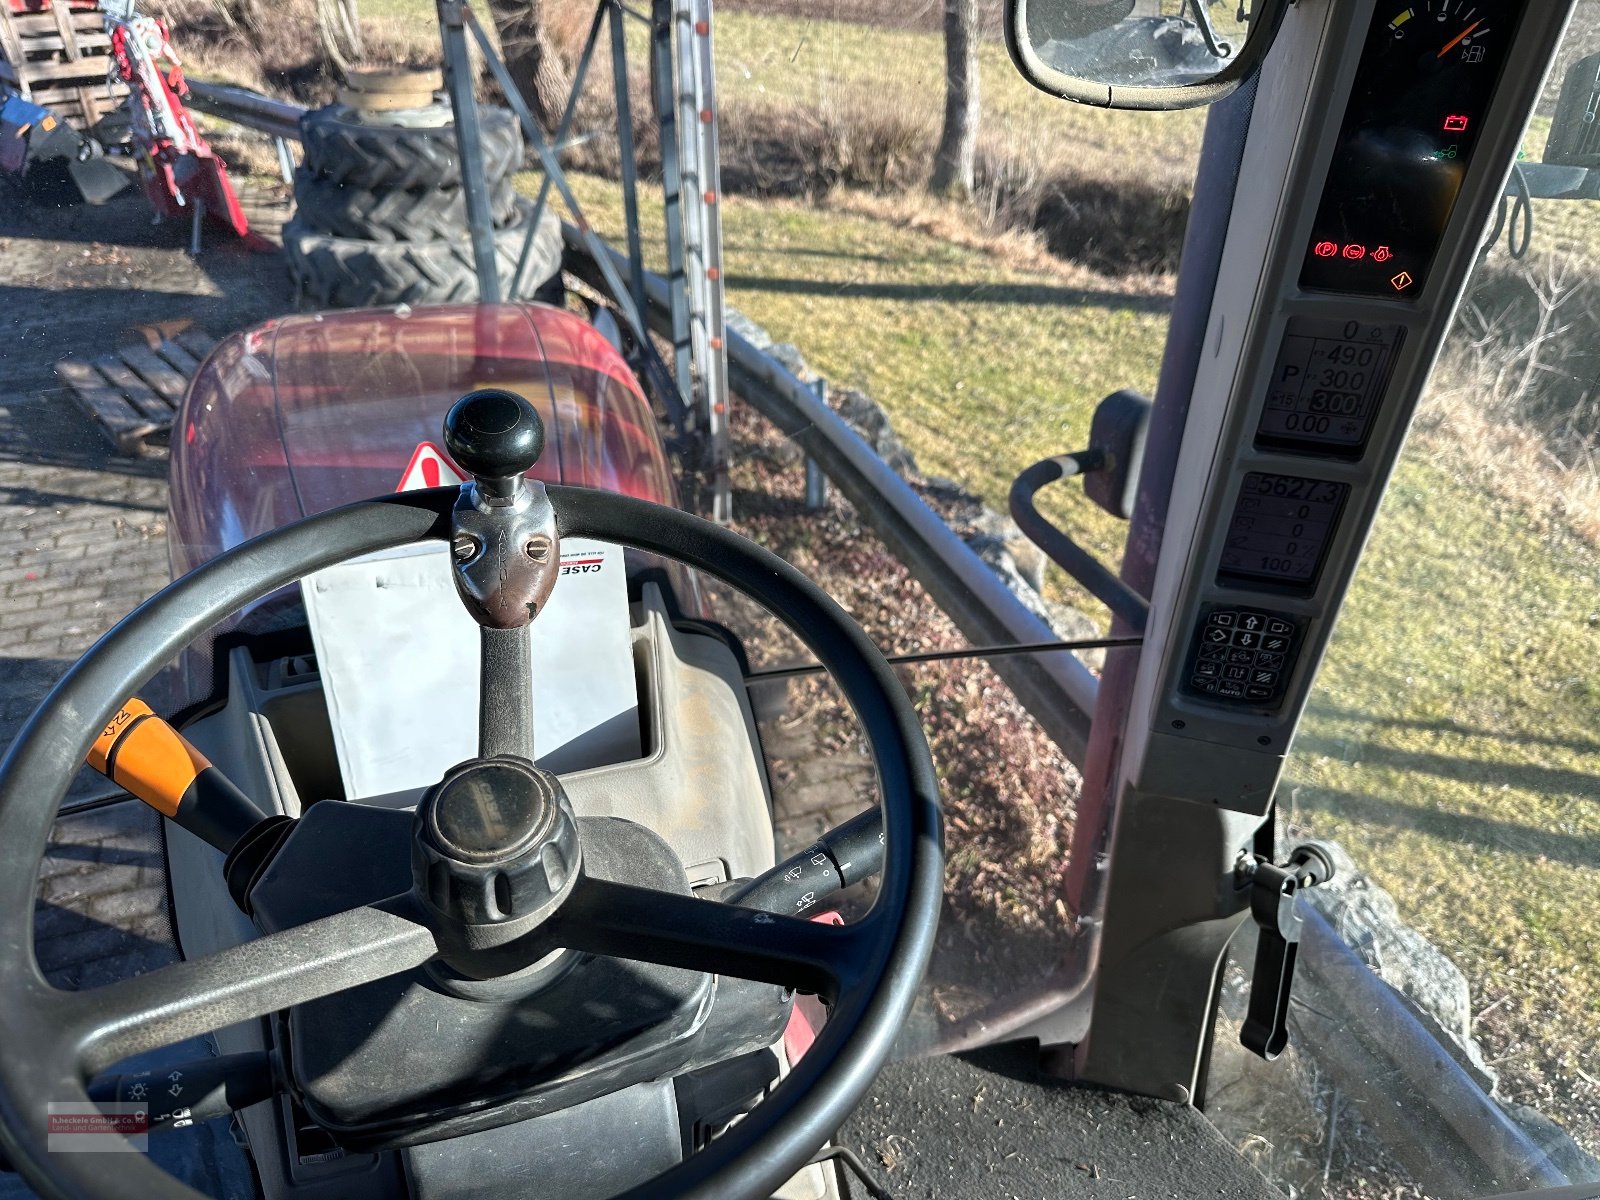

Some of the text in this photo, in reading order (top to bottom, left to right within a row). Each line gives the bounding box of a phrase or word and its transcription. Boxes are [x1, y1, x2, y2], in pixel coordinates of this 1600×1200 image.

[1343, 320, 1359, 340] 0
[1328, 345, 1373, 367] 49.0
[1281, 365, 1299, 382] P
[1319, 368, 1365, 391] 30.0
[1310, 391, 1357, 414] 3.00
[1285, 413, 1330, 434] 0.00
[1257, 475, 1339, 501] 5627.3
[1298, 504, 1310, 520] 0
[1292, 523, 1304, 538] 0
[1286, 541, 1298, 555] 0
[561, 564, 602, 576] CASE
[1261, 556, 1292, 573] 100
[1219, 687, 1241, 697] AUTO
